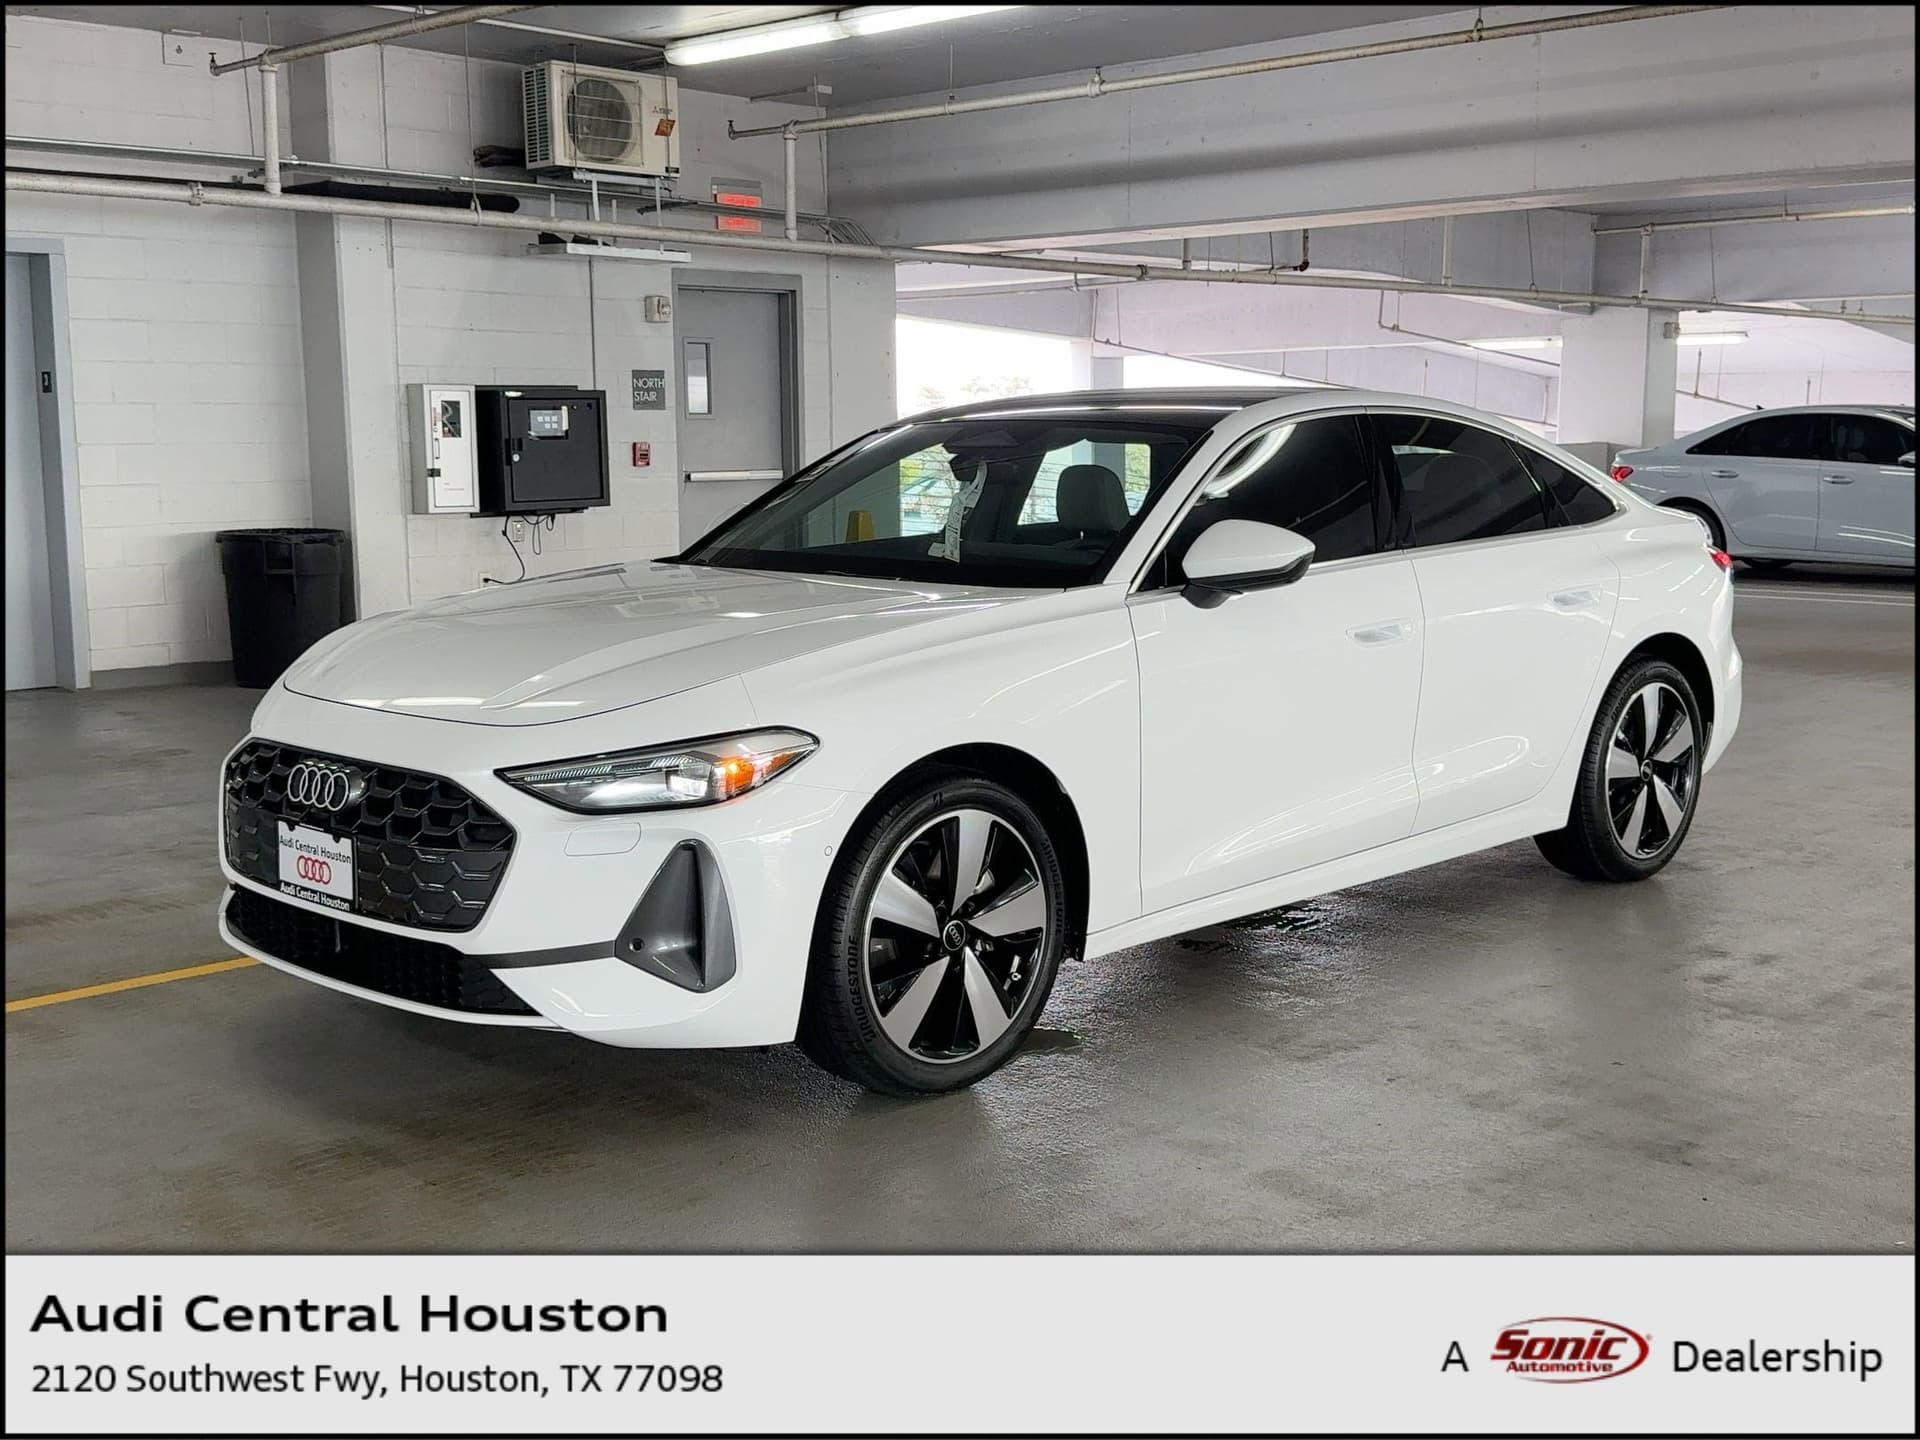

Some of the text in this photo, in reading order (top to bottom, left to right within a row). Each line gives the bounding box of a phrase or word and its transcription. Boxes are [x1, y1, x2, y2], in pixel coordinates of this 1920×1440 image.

[633, 377, 665, 389] NORTH
[634, 391, 657, 401] STAIR
[280, 835, 352, 864] Audi Central Houston
[280, 882, 350, 911] Audi Central Houston
[847, 935, 877, 1042] BRIDGESTONE
